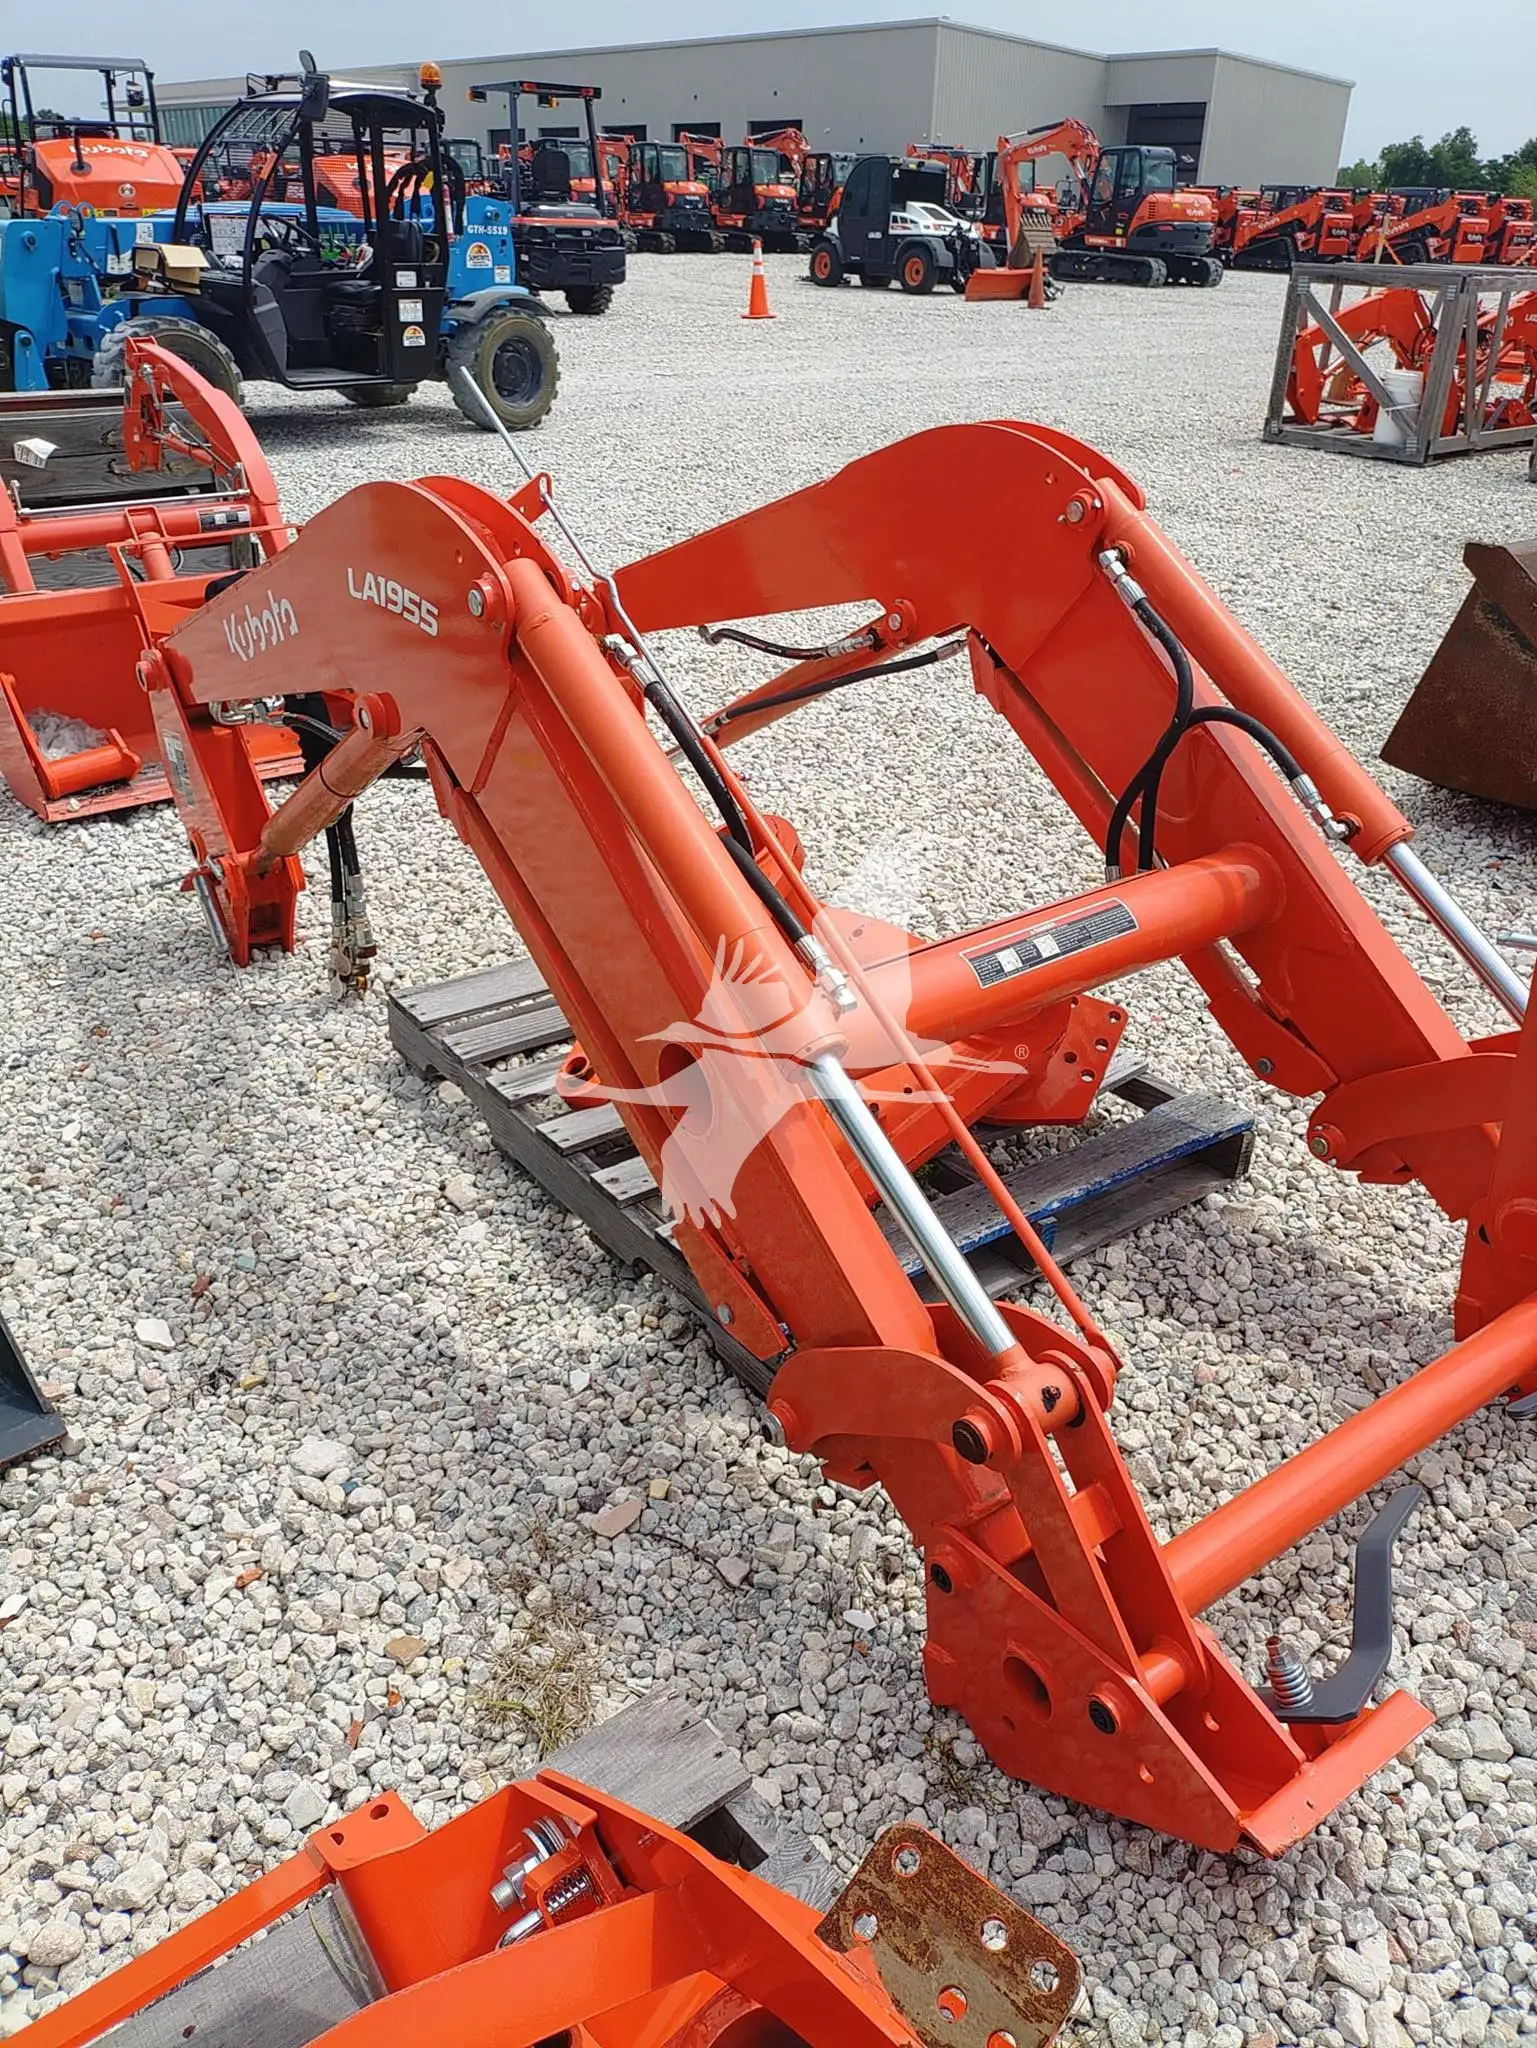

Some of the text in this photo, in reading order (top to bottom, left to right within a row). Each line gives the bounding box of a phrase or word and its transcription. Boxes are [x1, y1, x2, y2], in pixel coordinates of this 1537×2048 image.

[467, 224, 508, 236] GTH-5519
[222, 589, 299, 662] Kubota
[347, 567, 439, 637] LA1955
